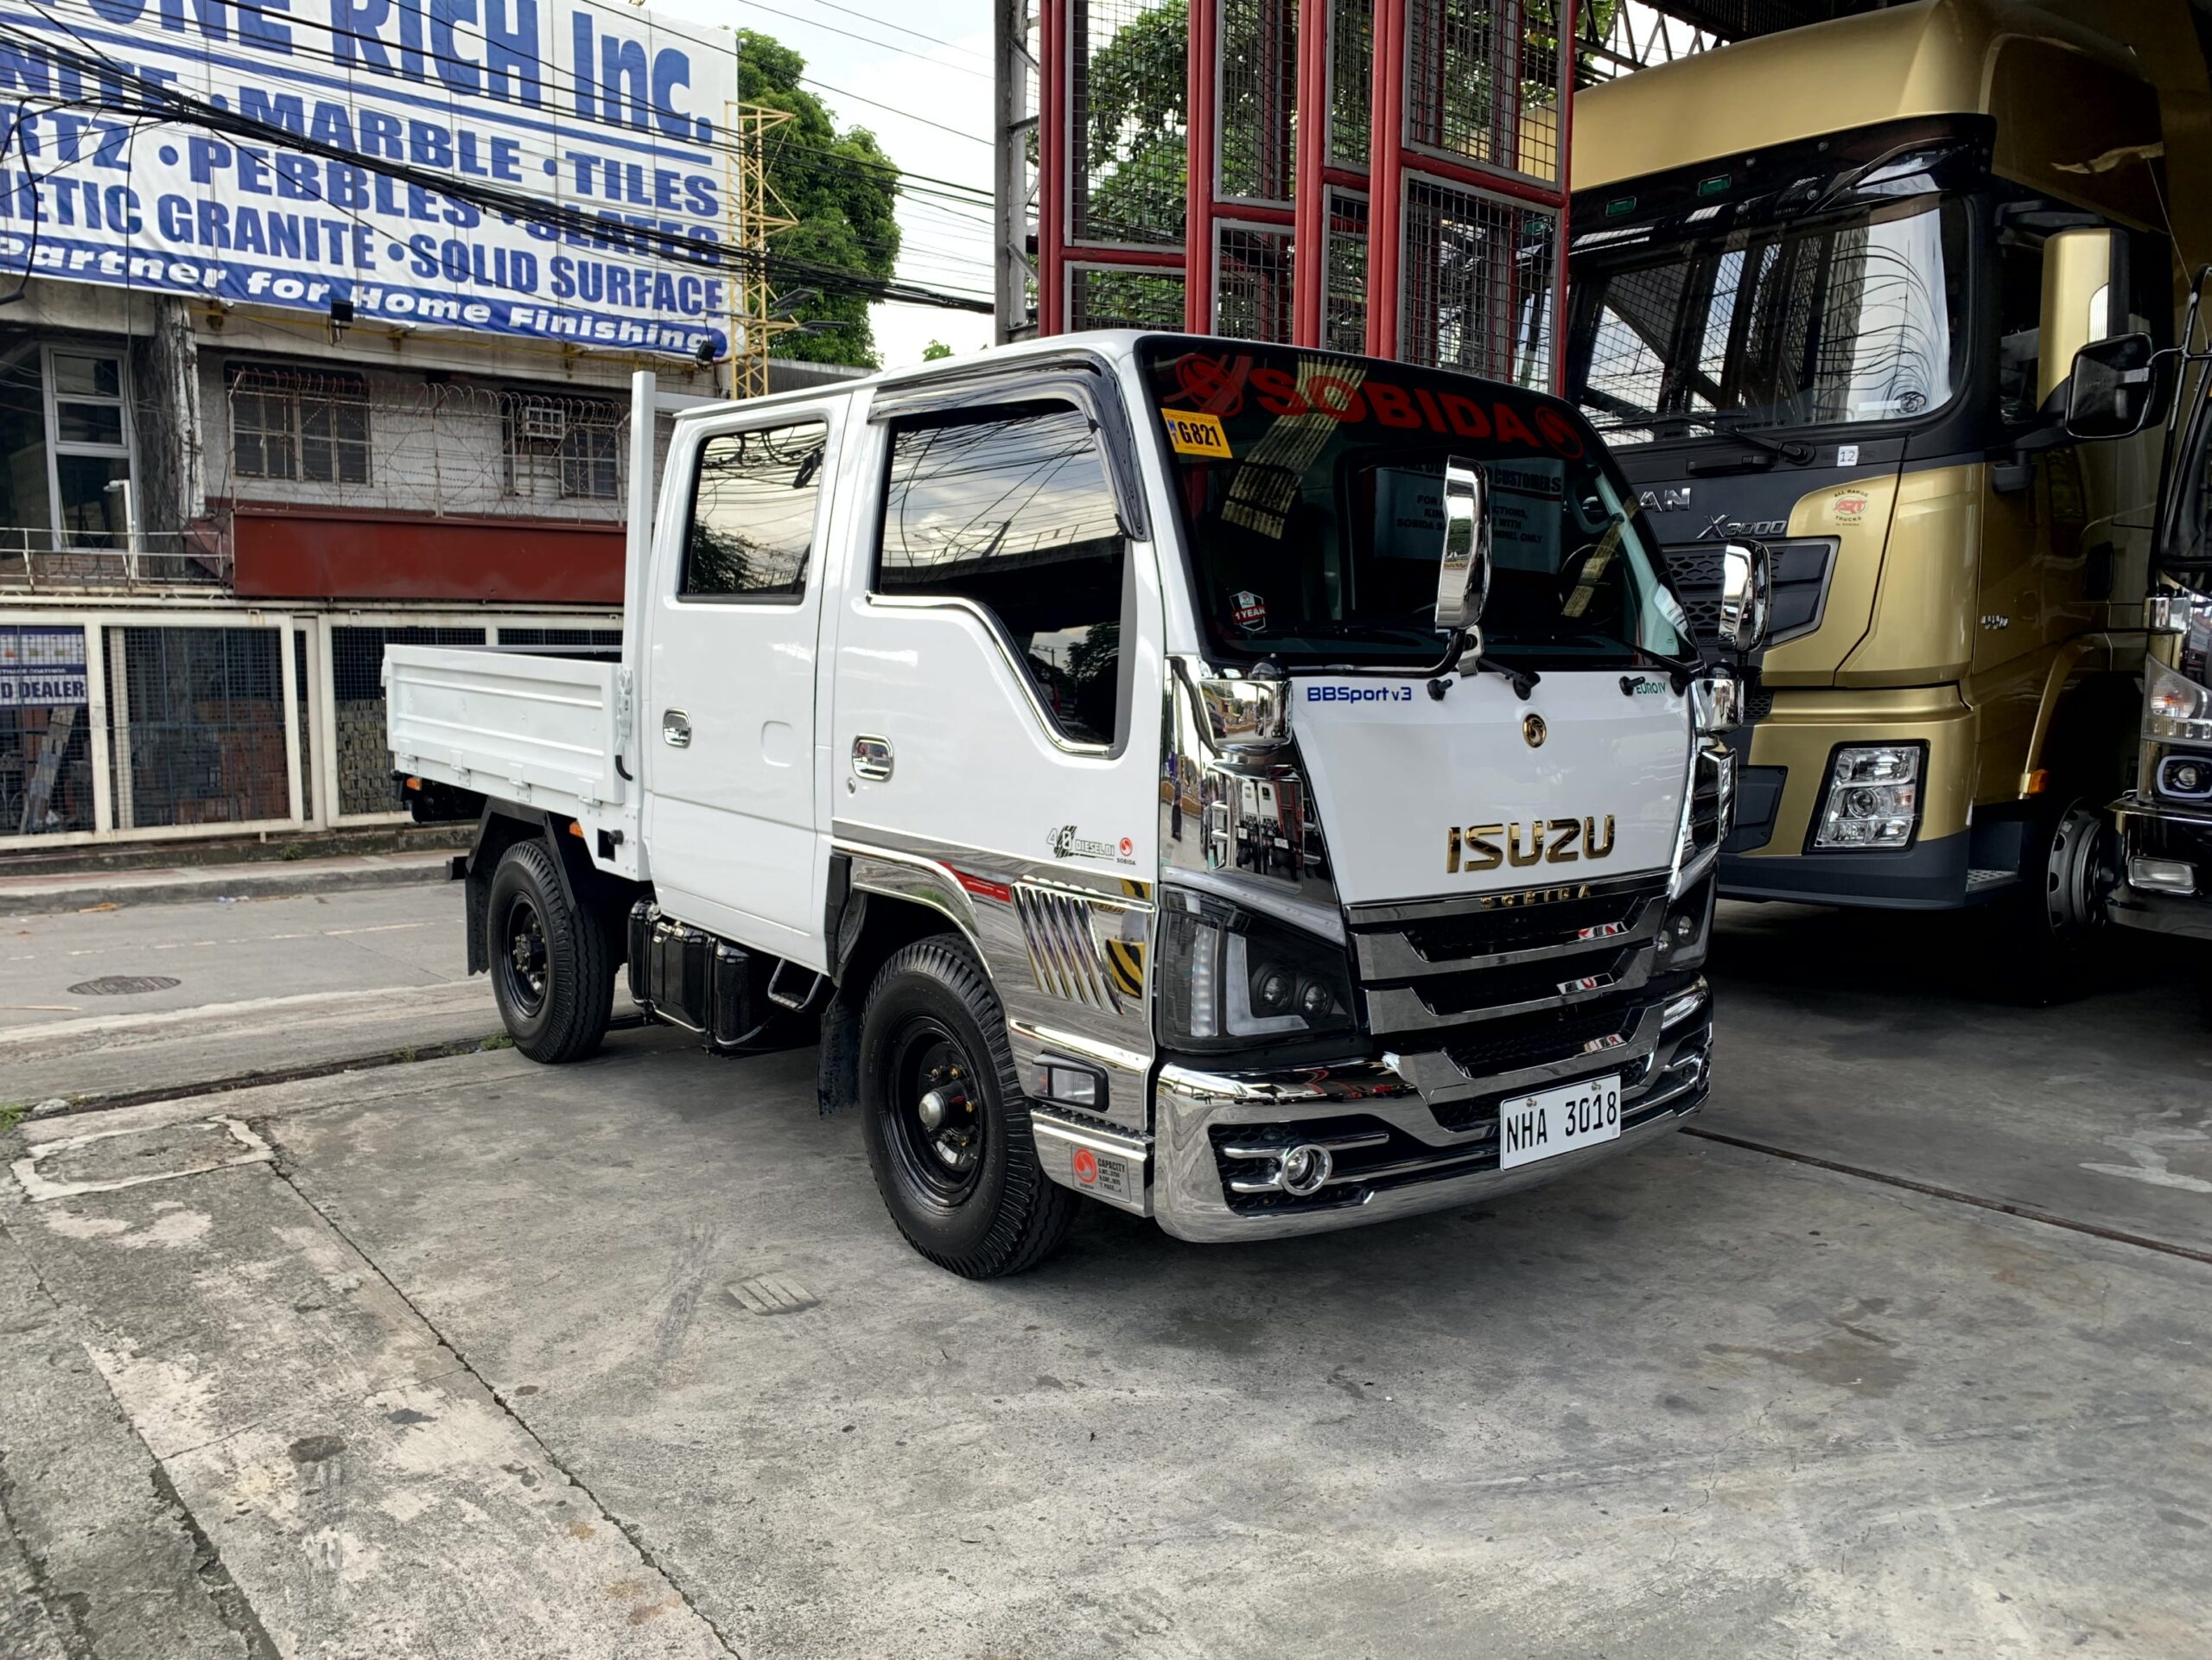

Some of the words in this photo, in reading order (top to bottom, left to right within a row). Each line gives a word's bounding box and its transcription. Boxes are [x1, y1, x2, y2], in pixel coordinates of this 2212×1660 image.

[330, 0, 541, 109] RICH
[571, 10, 713, 145] Inc.
[188, 136, 480, 228] PEBBLES
[239, 86, 522, 183] MARBLE
[566, 150, 719, 217] TILES
[157, 194, 376, 271] GRANITE
[409, 233, 538, 294] SOLID
[550, 255, 723, 319] SURFACE
[247, 271, 330, 302] for
[349, 284, 492, 323] Home
[508, 307, 714, 353] Finishing
[1178, 421, 1221, 447] G821
[1249, 367, 1541, 448] SOBIDA
[1494, 467, 1562, 493] CUSTOMERS
[1840, 451, 1855, 462] 12
[1696, 513, 1788, 539] X3000
[18, 681, 85, 698] DEALER
[1446, 813, 1615, 874] ISUZU
[1478, 883, 1592, 911] SOBIDA
[1506, 1108, 1548, 1154] NHA
[1565, 1091, 1617, 1137] 3018
[1098, 1158, 1125, 1173] CAPACITY
